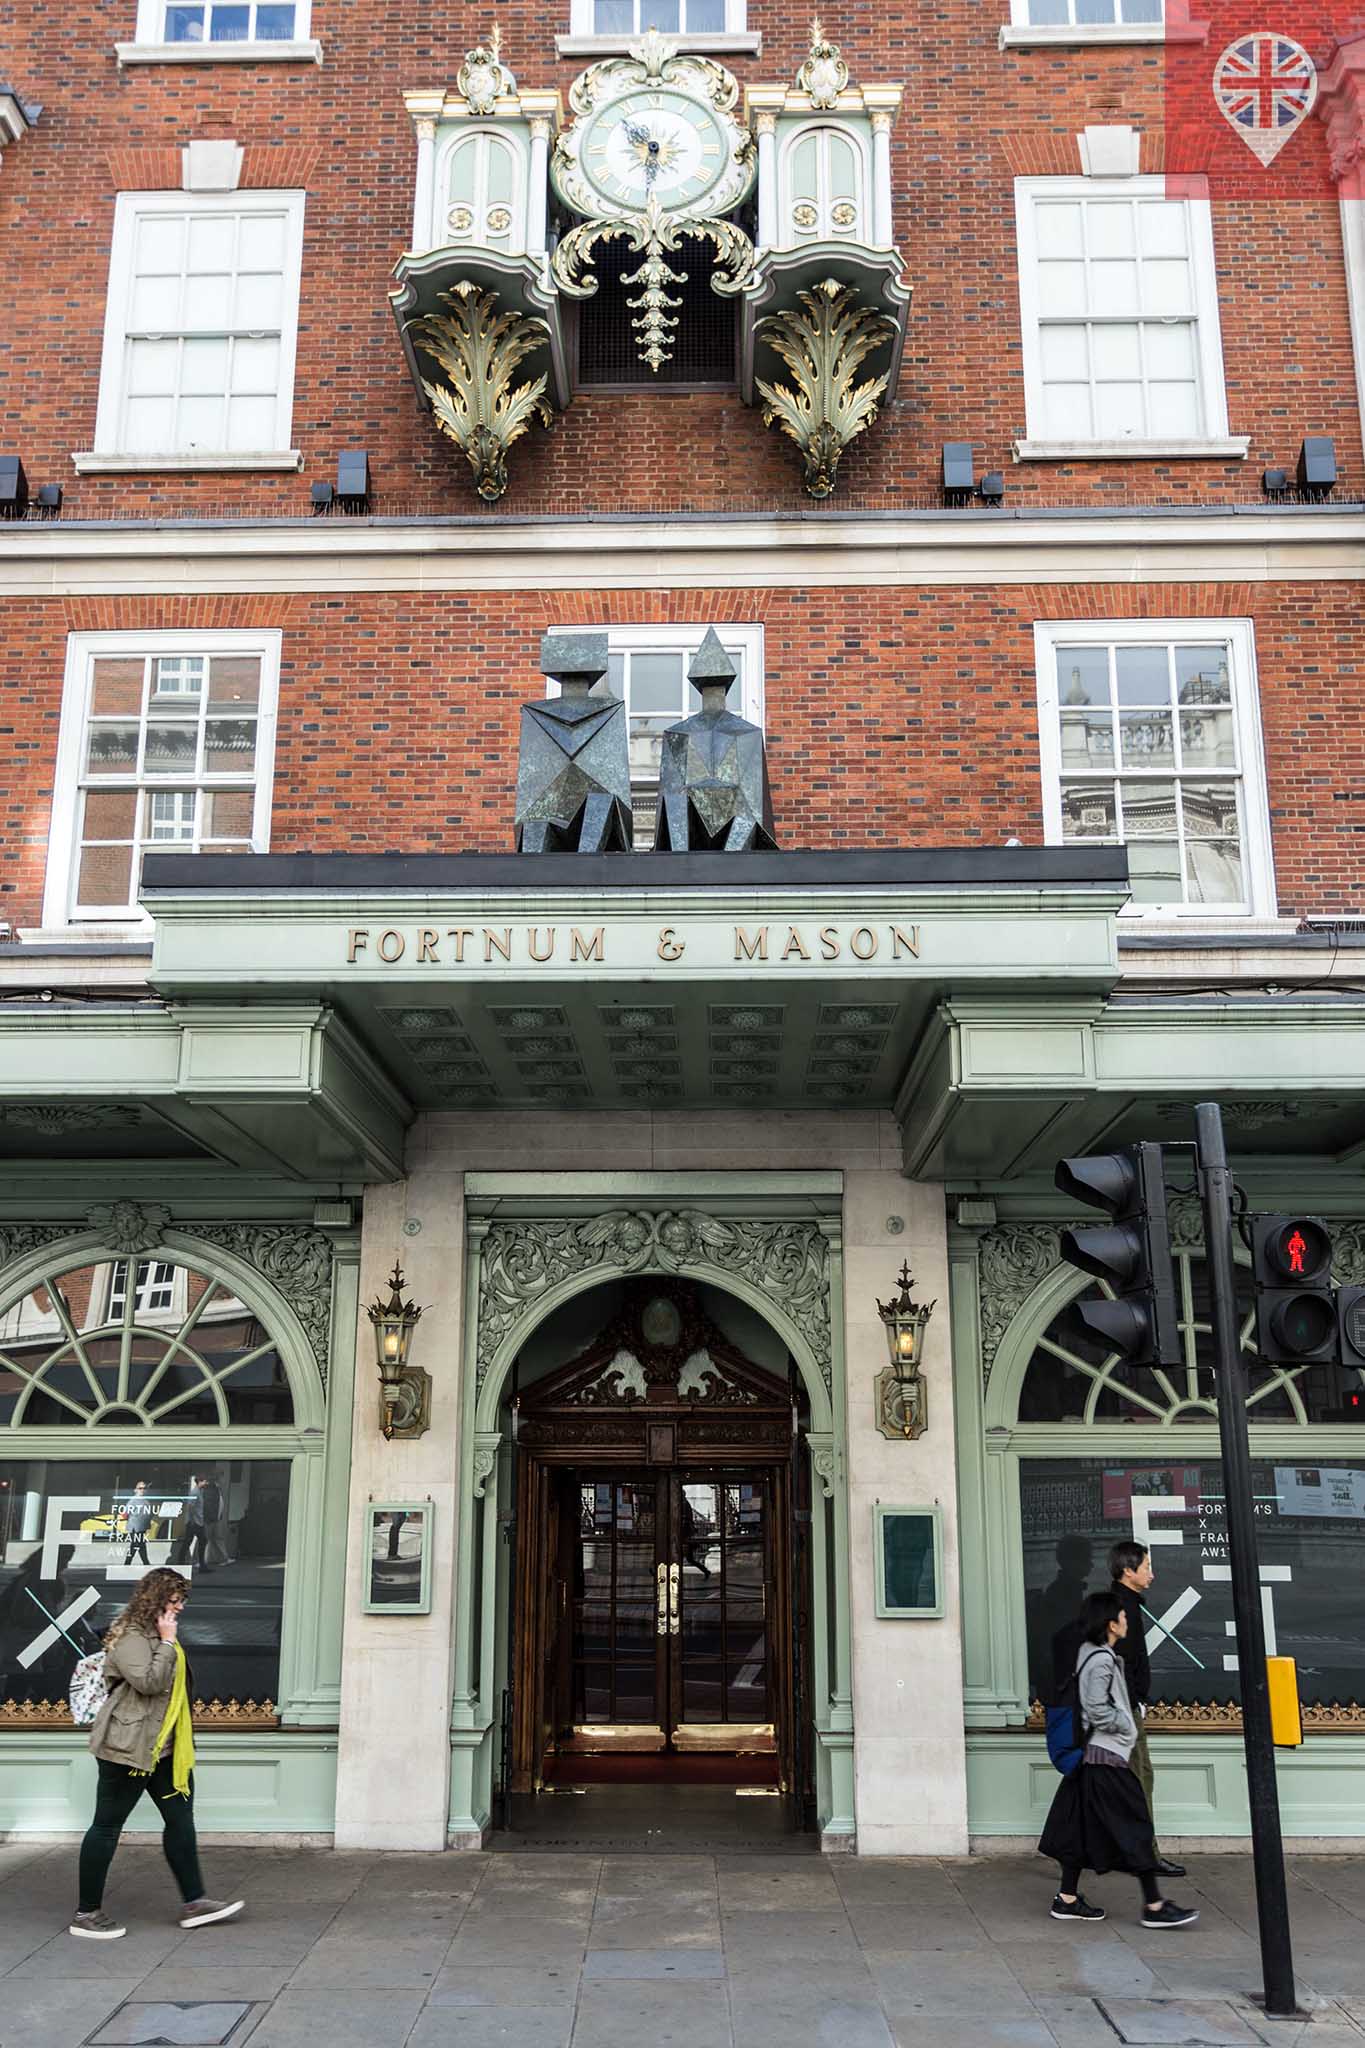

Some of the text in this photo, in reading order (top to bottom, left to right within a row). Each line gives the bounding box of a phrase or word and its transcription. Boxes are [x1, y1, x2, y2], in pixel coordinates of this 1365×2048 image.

[346, 924, 921, 963] FORTNUM & MASON
[111, 1504, 183, 1515] FORTNUS
[1199, 1518, 1207, 1529] X
[109, 1532, 150, 1543] FRANK
